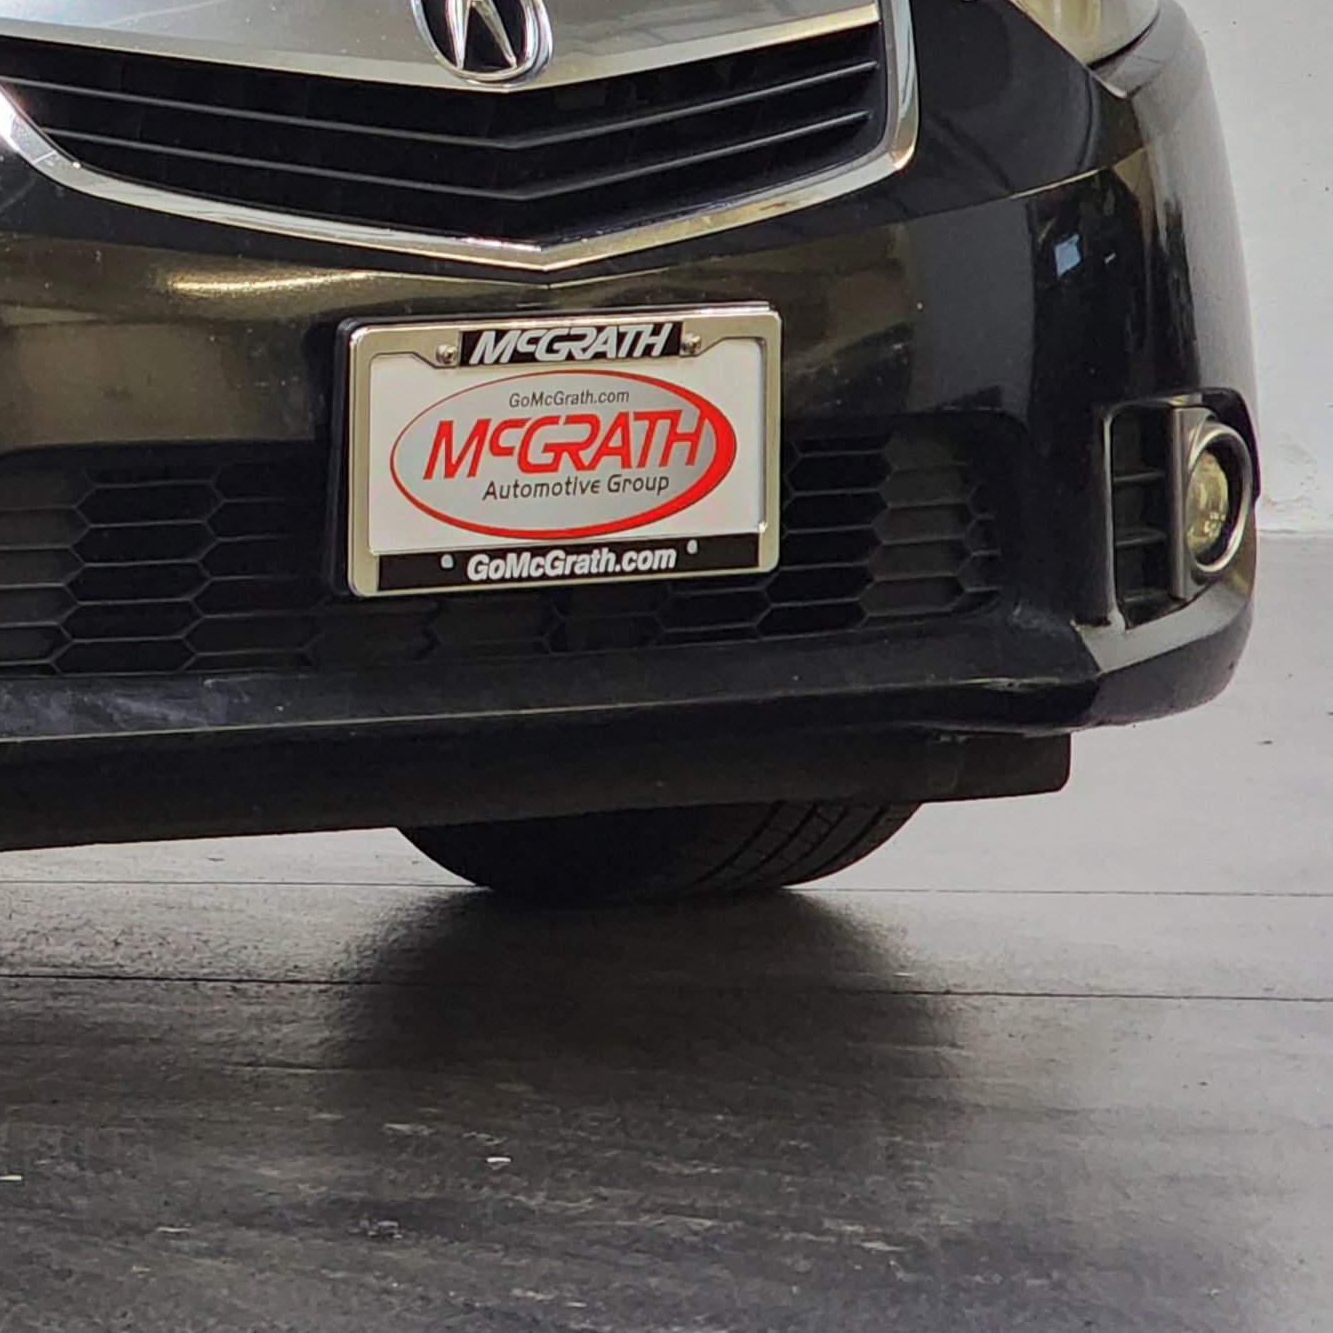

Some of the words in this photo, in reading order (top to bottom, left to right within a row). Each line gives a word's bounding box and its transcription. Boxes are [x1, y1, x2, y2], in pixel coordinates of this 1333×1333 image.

[469, 323, 673, 364] McGRATH
[508, 388, 630, 409] GoMcGrath.com
[422, 409, 708, 480] McGRATH
[482, 478, 601, 501] Automotive
[606, 473, 670, 497] Group
[466, 546, 677, 582] GoMcGrath.com
